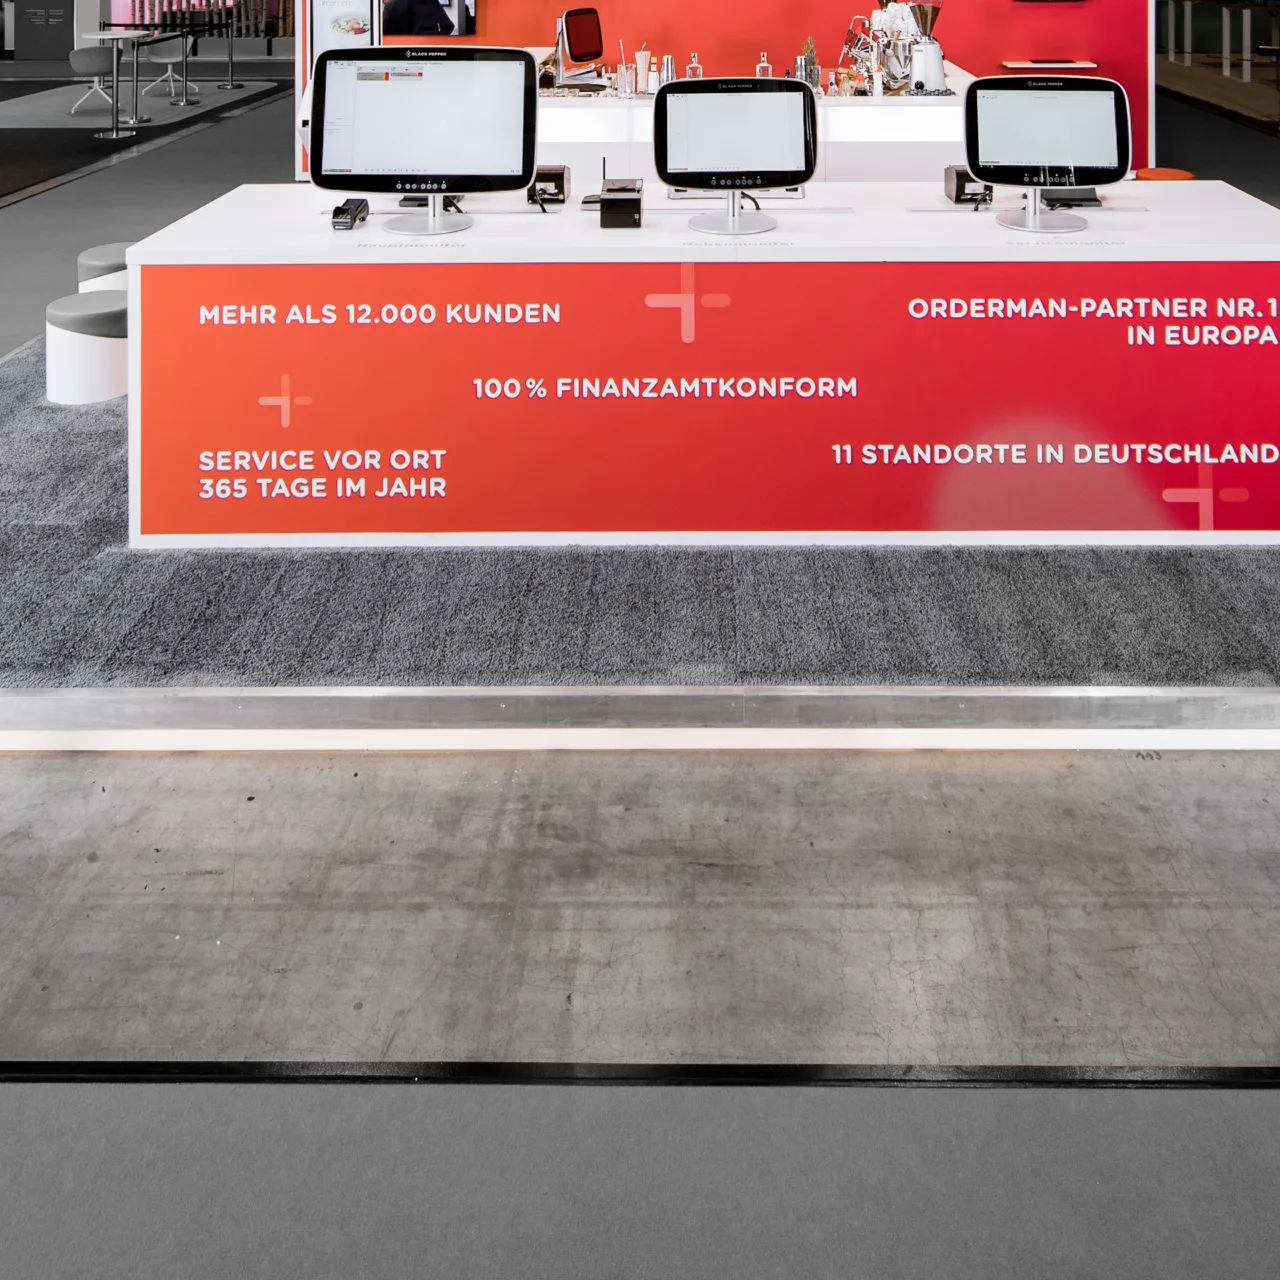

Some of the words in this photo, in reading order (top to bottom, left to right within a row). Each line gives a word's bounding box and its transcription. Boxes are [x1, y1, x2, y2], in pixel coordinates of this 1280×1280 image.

[199, 303, 279, 325] MEHR
[286, 303, 340, 325] ALS
[347, 303, 438, 325] 12.000
[446, 302, 561, 325] KUNDEN
[908, 297, 1210, 319] ORDERMAN-PARTNER
[1127, 324, 1155, 346] IN
[1163, 324, 1280, 346] EUROPA
[556, 377, 858, 400] FINANZAMTKONFORM
[198, 450, 315, 472] SERVICE
[323, 450, 380, 472] VOR
[387, 450, 446, 472] ORT
[831, 443, 854, 465] 11
[861, 443, 1029, 465] STANDORTE
[1036, 443, 1064, 465] IN
[1073, 442, 1280, 465] DEUTSCHLAND
[198, 478, 250, 499] 365
[257, 478, 331, 499] TAGE
[336, 478, 363, 499] IM
[371, 477, 447, 499] JAHR
